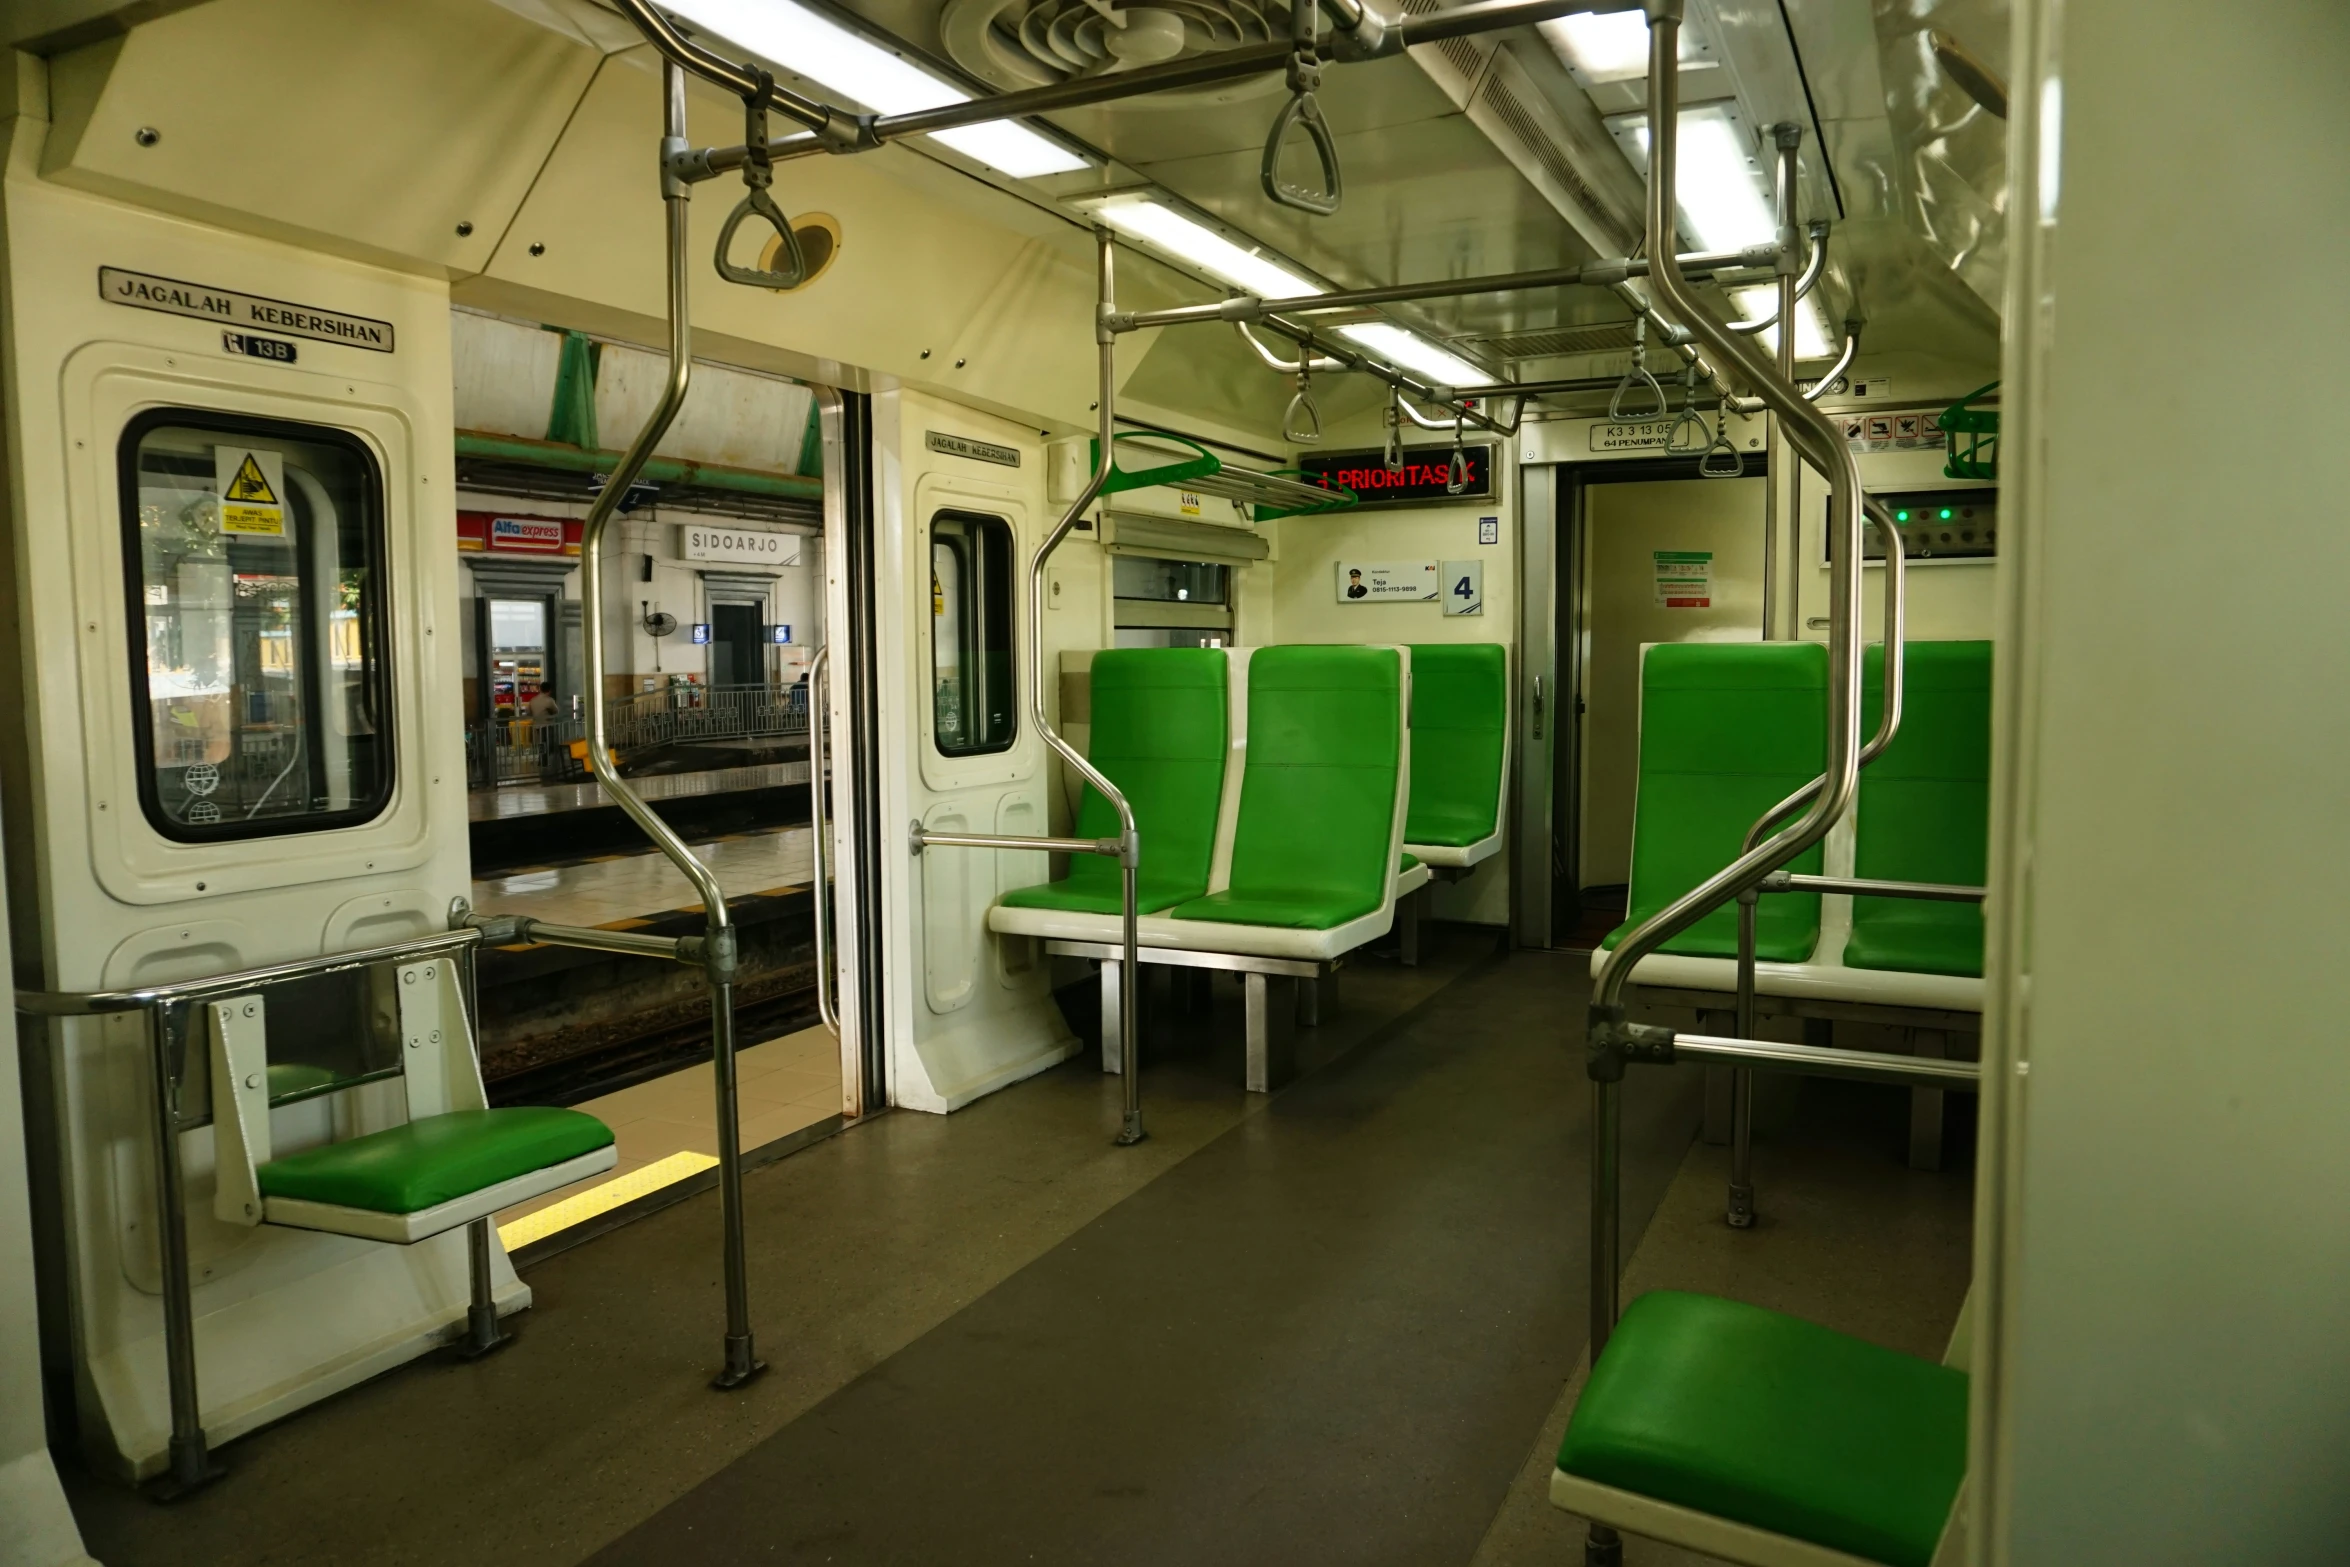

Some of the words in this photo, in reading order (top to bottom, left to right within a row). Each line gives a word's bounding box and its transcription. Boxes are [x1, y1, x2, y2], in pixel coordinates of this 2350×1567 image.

[118, 279, 232, 316] JAGALAH
[250, 304, 382, 344] KEBERSIHAN
[254, 339, 289, 359] 13B
[1607, 426, 1623, 437] K3
[1628, 426, 1635, 436] 3
[1640, 425, 1652, 435] 13
[931, 437, 966, 453] JAGALAH
[1604, 439, 1617, 447] 64
[1338, 464, 1449, 490] PRIORITAS
[629, 492, 640, 504] 1
[494, 520, 520, 535] Alfa
[521, 524, 559, 538] express
[692, 532, 778, 553] SIDOARJO
[1372, 578, 1387, 586] Teja
[1453, 576, 1474, 600] 4
